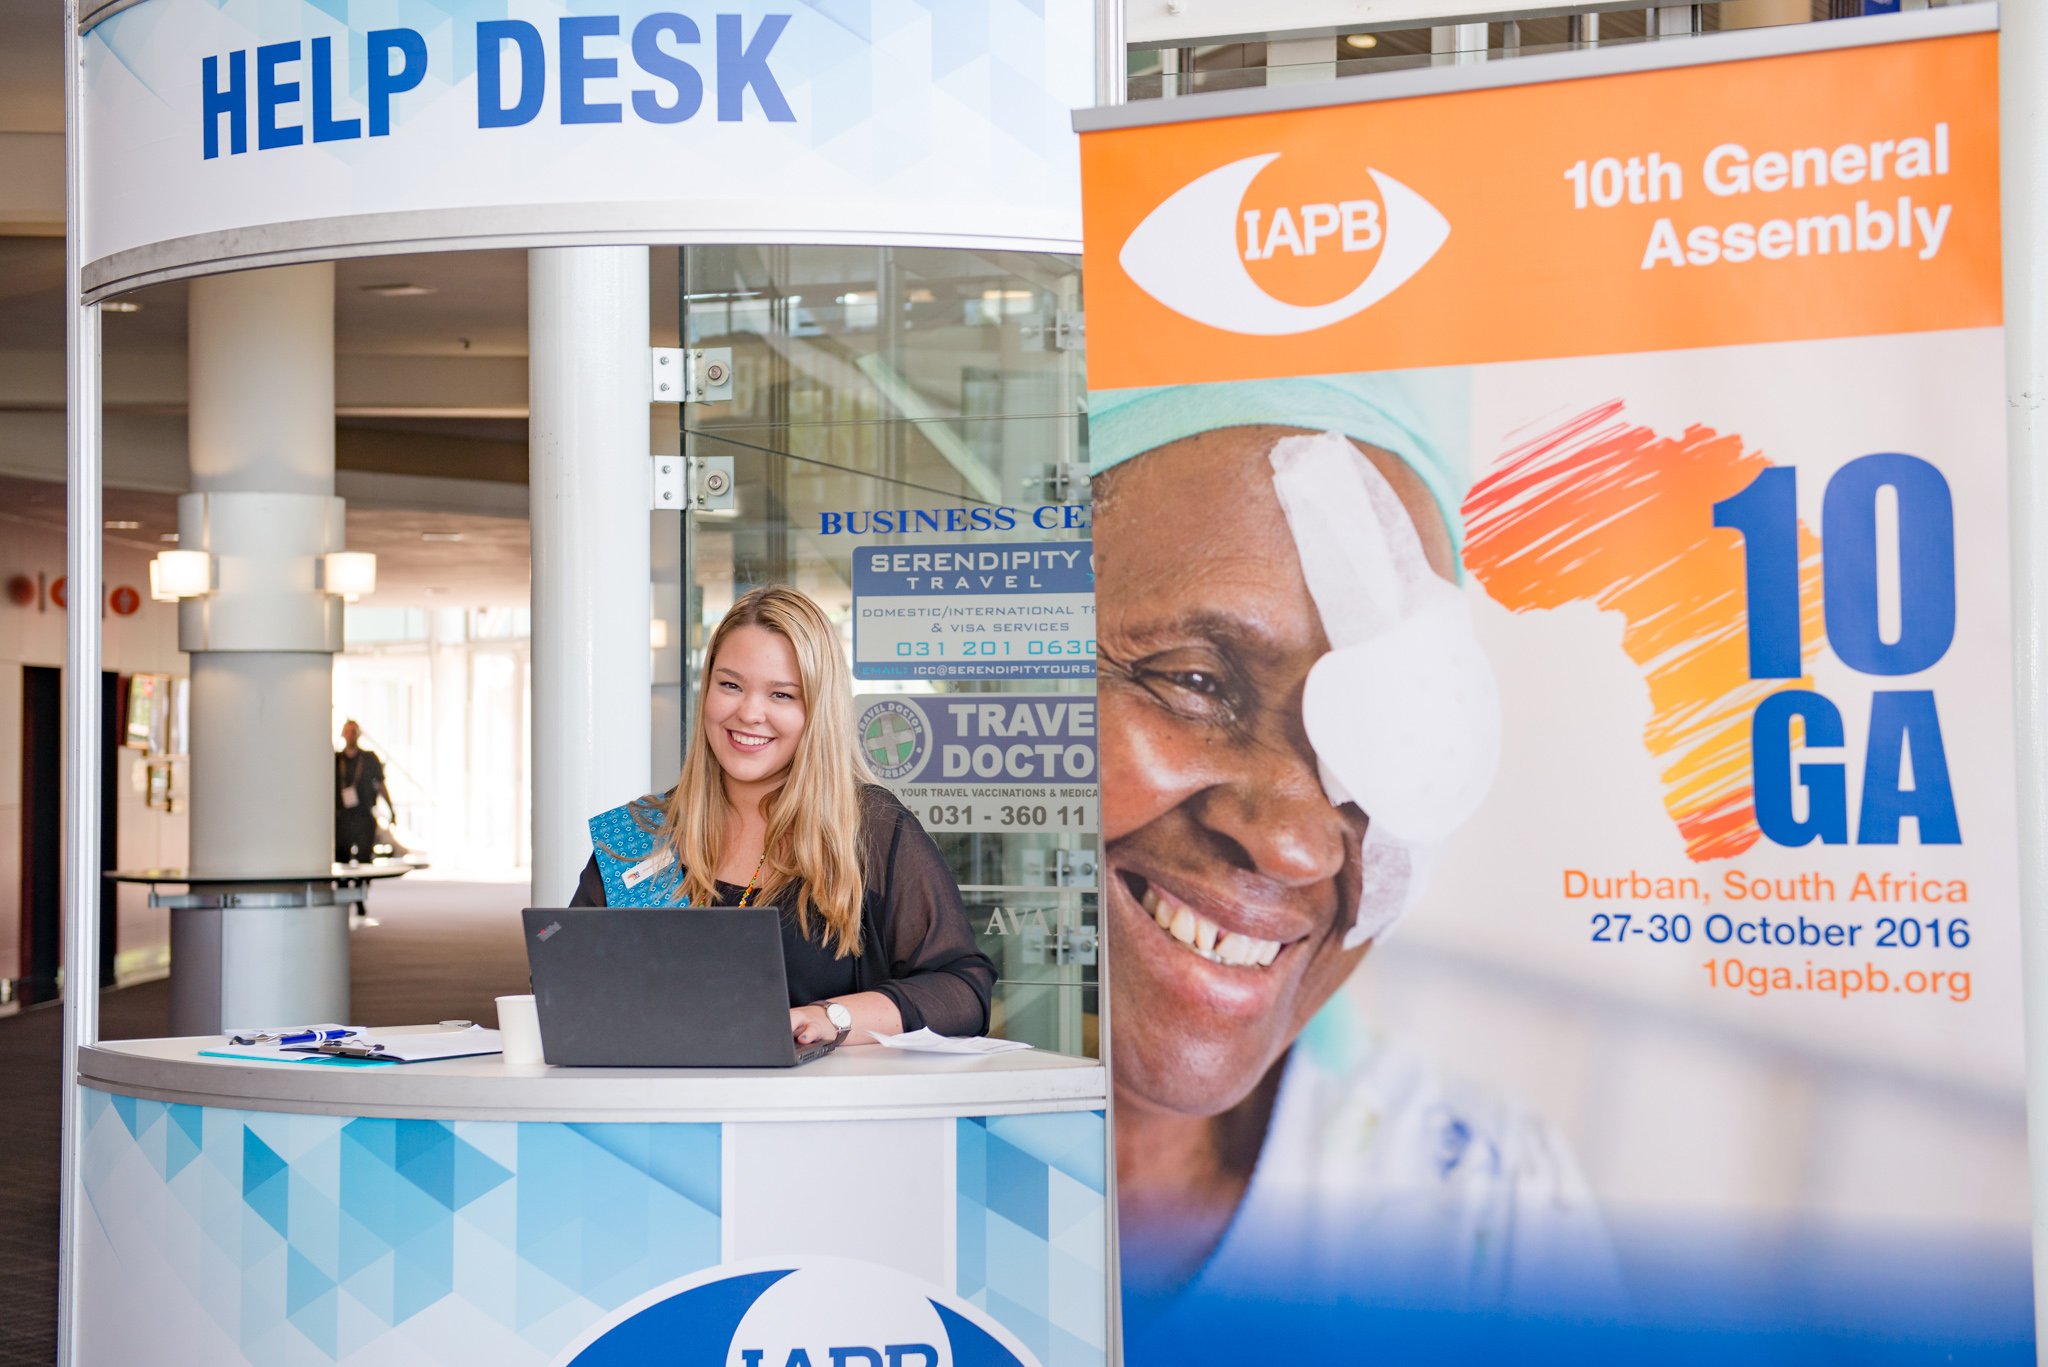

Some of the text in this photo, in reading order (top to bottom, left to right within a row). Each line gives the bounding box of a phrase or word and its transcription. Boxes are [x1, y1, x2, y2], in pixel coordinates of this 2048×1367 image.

[202, 12, 797, 160] HELP DESK
[1564, 123, 1950, 209] 10th General
[1244, 198, 1382, 261] IAPB
[1641, 197, 1953, 270] Assembly
[818, 505, 1092, 535] BUSINESS CE
[871, 550, 1080, 573] SERENDIPITY
[1713, 452, 1956, 679] 10
[906, 576, 1042, 590] TRAVEL
[862, 605, 1074, 619] DOMESTIC/INTERNATIONAL
[931, 622, 1069, 633] & VISA SERVICES
[896, 641, 945, 656] 031
[962, 641, 1010, 656] 201
[888, 702, 922, 734] DOCTOR
[1752, 689, 1962, 847] GA
[900, 788, 928, 798] YOUR
[932, 788, 968, 798] TRAVEL
[973, 788, 1046, 798] VACCINATIONS
[1049, 788, 1057, 798] &
[929, 805, 973, 825] 031
[1000, 805, 1047, 826] 360
[1056, 805, 1085, 826] 11
[1563, 869, 1969, 905] Durban, South Africa
[984, 907, 1098, 937] AVAIL
[1591, 914, 1970, 948] 27-30 October 2016
[1702, 958, 1972, 1002] 10ga.iapb.org
